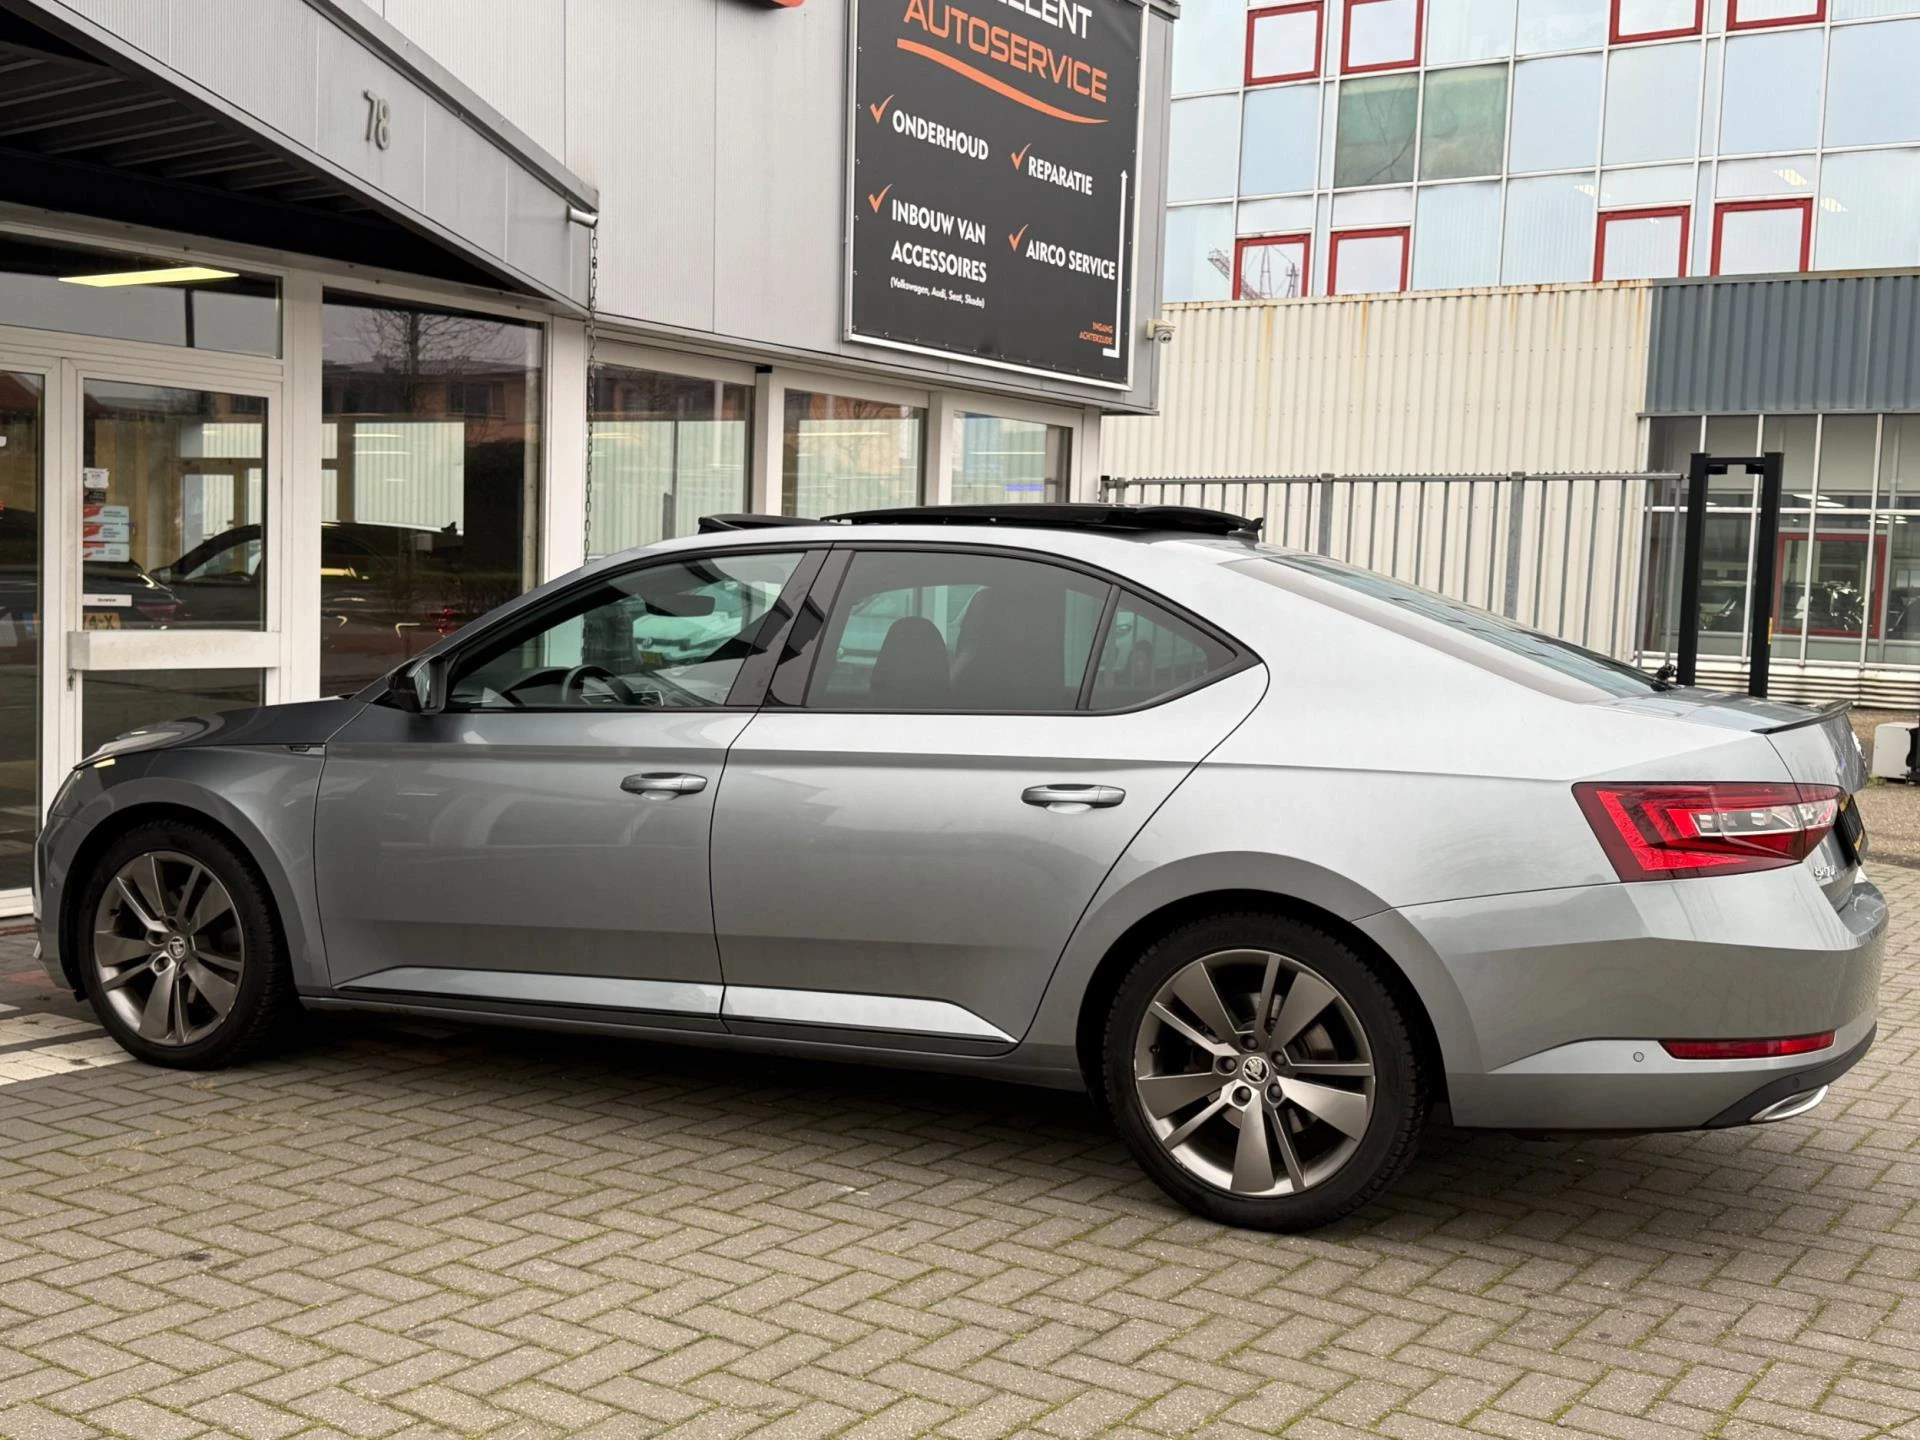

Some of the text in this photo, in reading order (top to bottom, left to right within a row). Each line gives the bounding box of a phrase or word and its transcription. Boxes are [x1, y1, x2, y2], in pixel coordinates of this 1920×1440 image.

[904, 0, 1108, 103] AUTOSERVICE
[363, 89, 391, 151] 78
[892, 109, 989, 161] ONDERHOUD
[1028, 156, 1093, 196] REPARATIE
[892, 199, 986, 246] INBOUW VAN
[891, 240, 987, 284] ACCESSOIRES
[1026, 239, 1116, 281] AIRCO SERVICE
